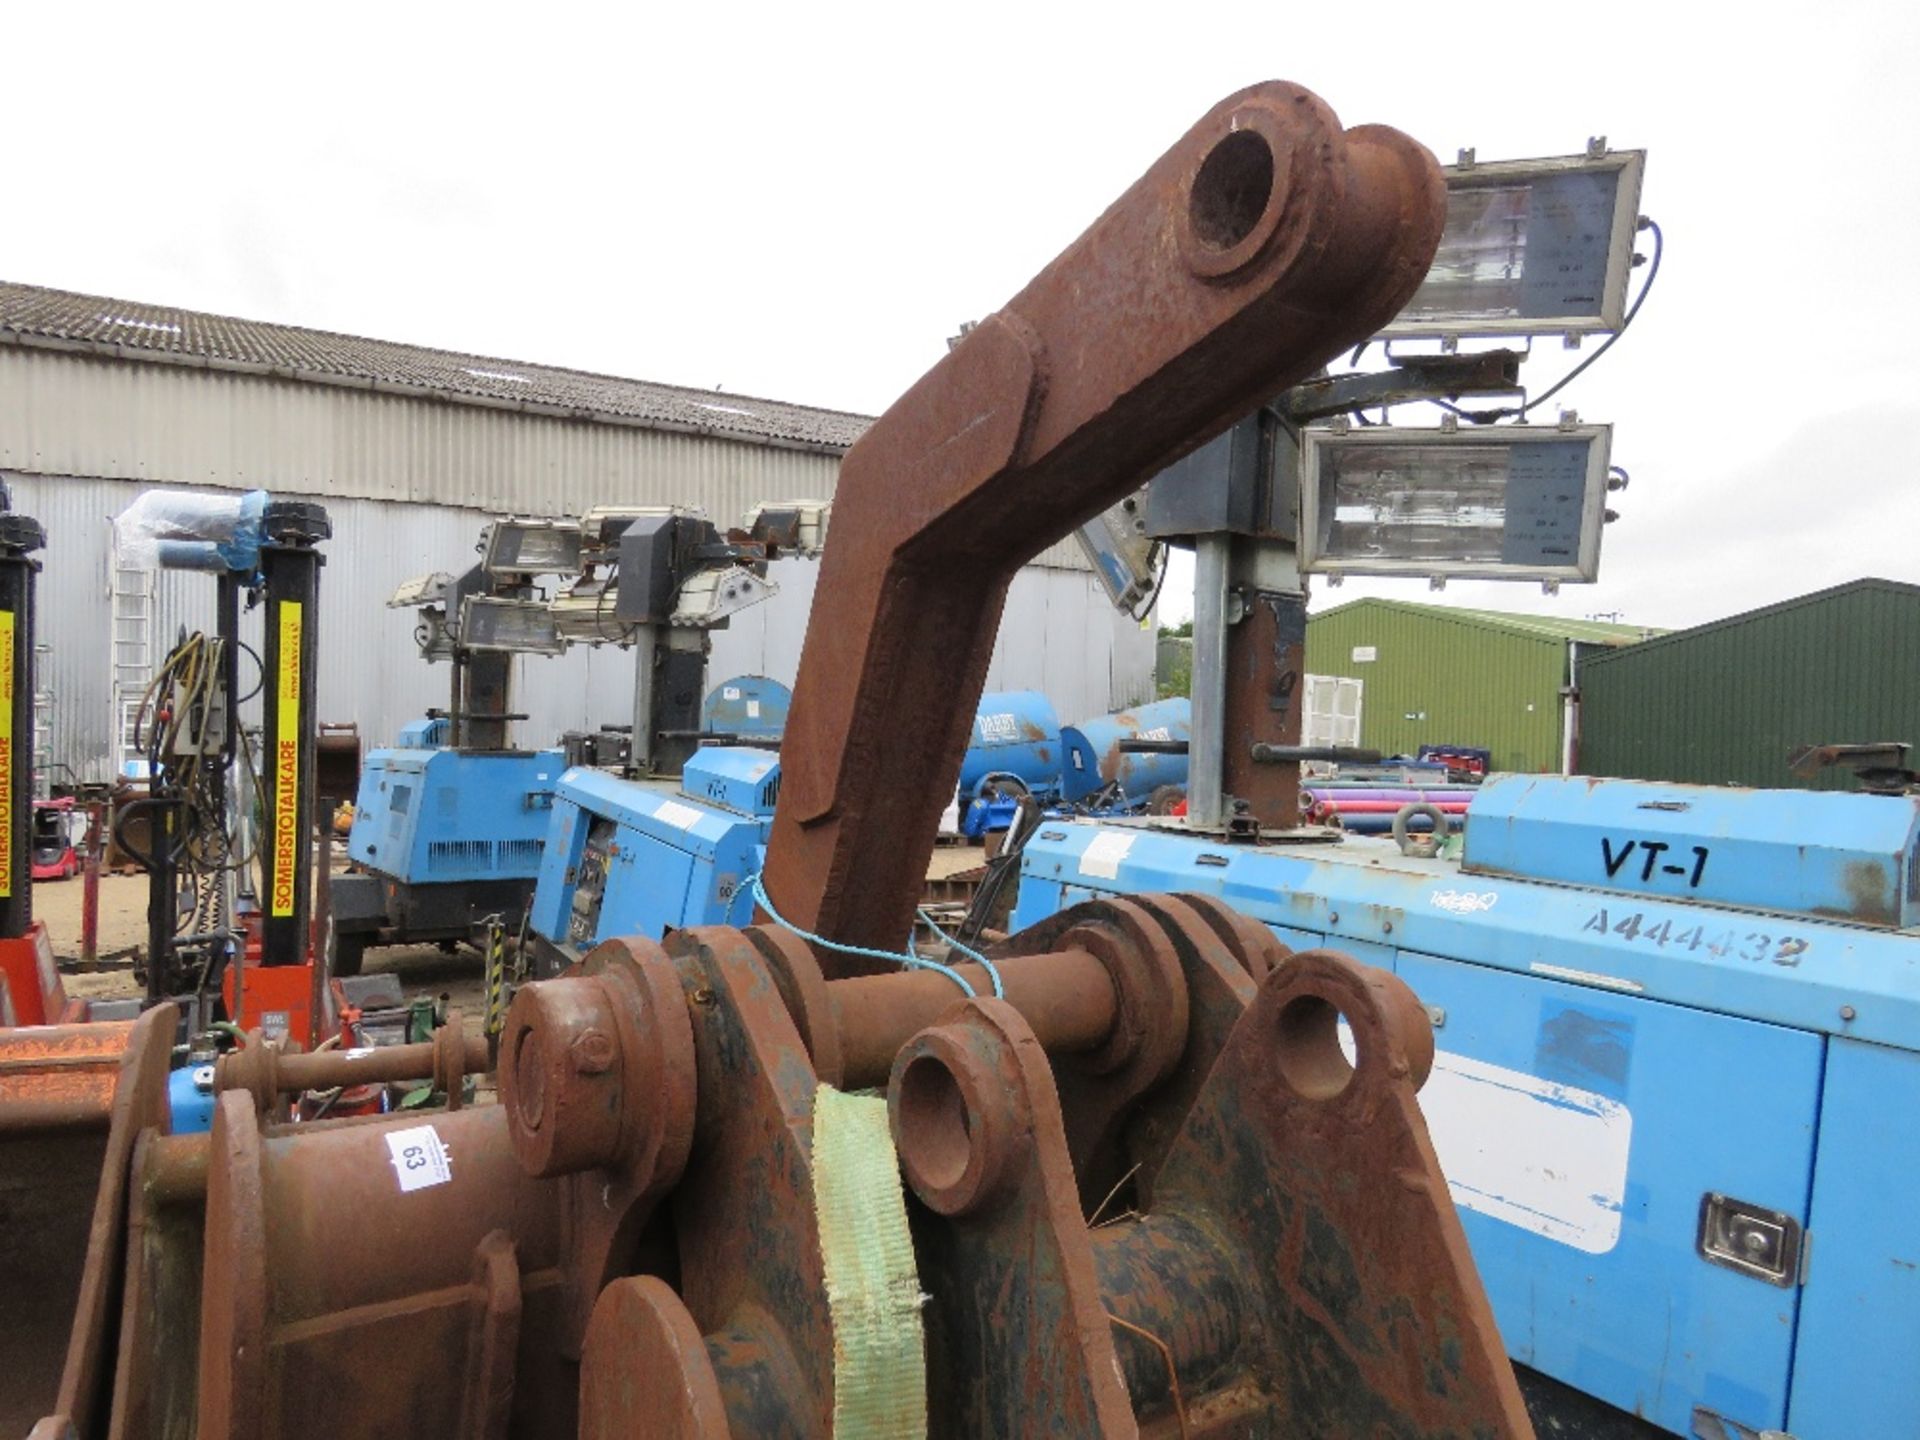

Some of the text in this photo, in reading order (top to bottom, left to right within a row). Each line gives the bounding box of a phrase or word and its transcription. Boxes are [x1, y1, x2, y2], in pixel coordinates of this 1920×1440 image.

[276, 740, 296, 909] SOMERSTOTALKARE
[1601, 837, 1709, 888] VT-1
[1584, 908, 1809, 967] A444432
[403, 1146, 427, 1170] 63
